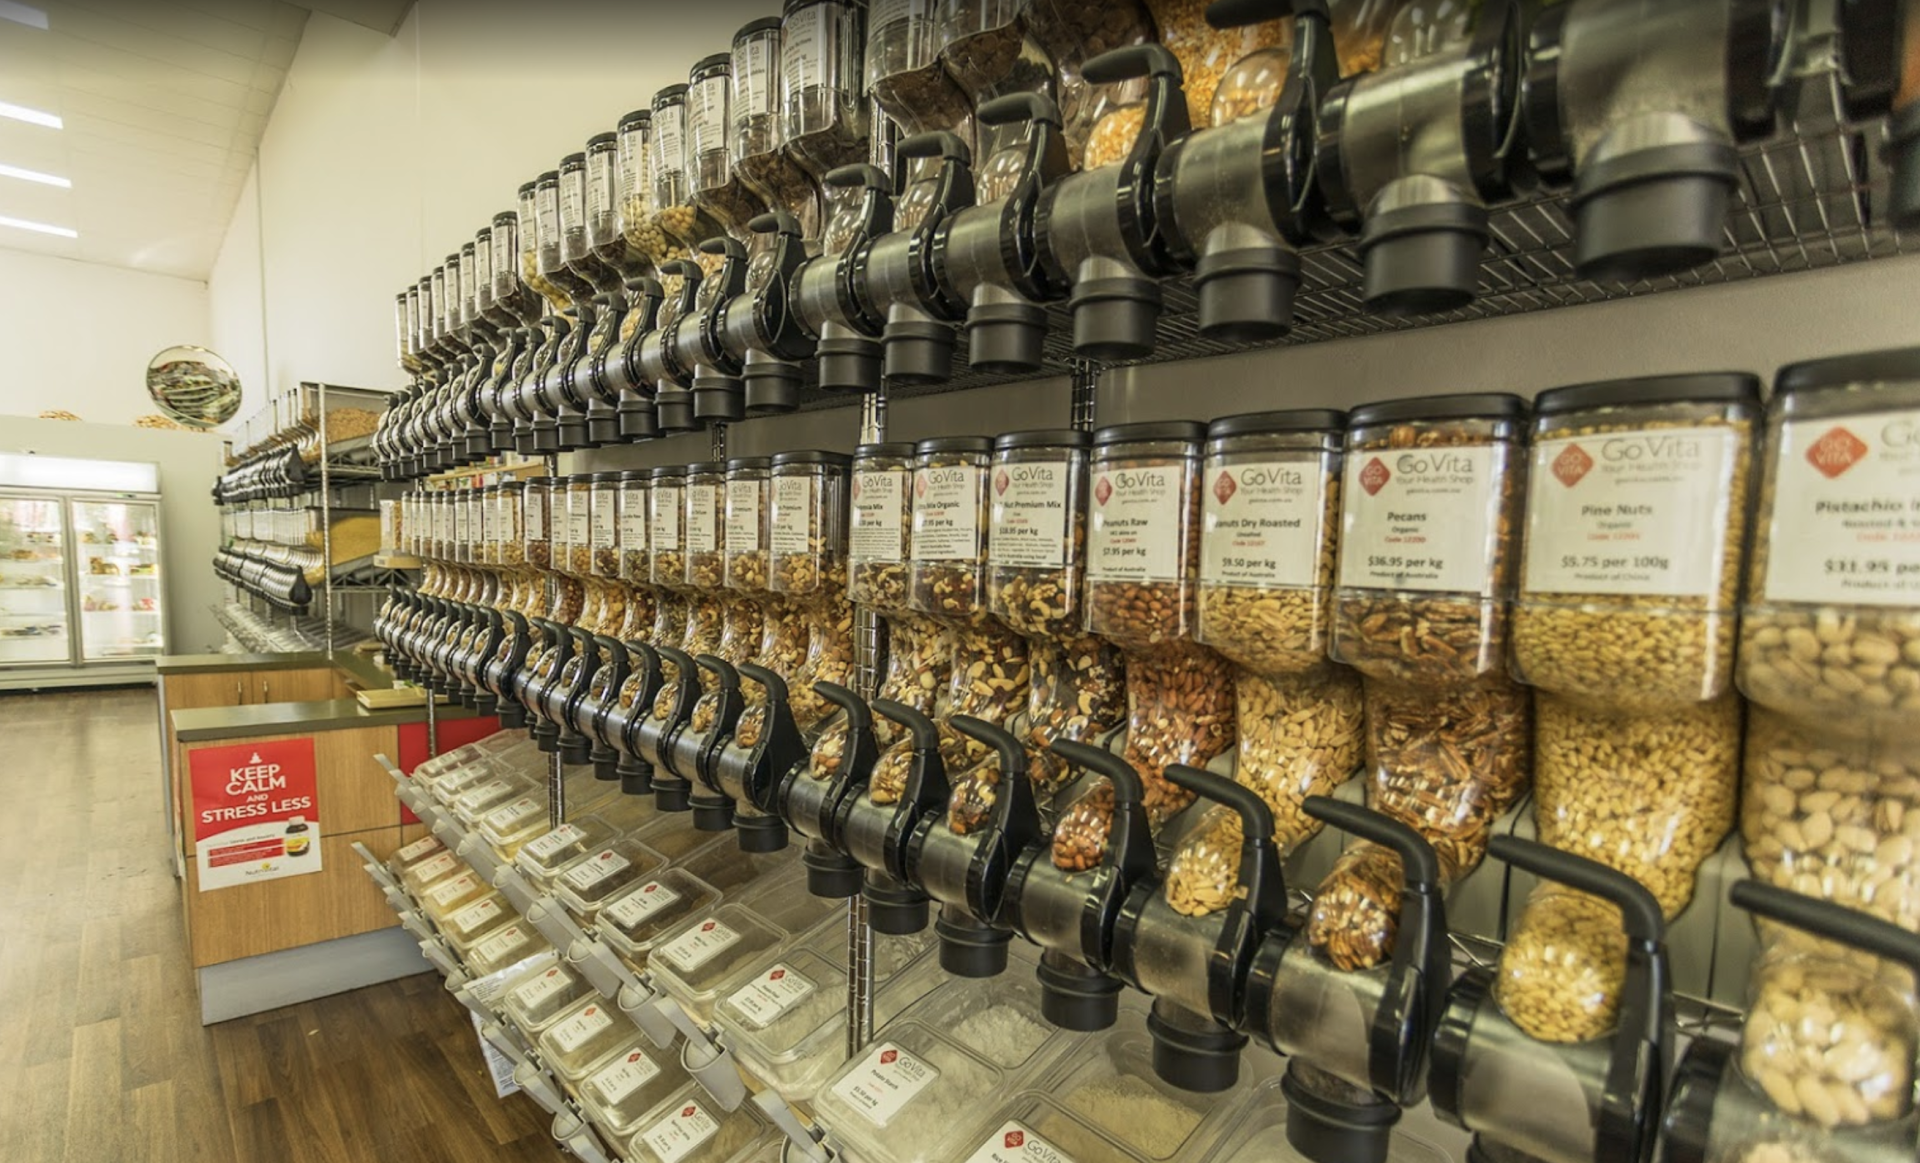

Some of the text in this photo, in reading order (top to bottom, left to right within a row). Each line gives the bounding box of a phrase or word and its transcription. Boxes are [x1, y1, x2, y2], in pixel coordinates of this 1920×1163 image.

[937, 501, 960, 511] Organic
[1014, 501, 1045, 509] Premium
[1046, 501, 1062, 509] Mix
[1581, 504, 1654, 517] Pine Nuts
[1815, 500, 1904, 515] Pistachio
[1130, 518, 1148, 526] Raw
[1387, 512, 1427, 523] Pecans
[1241, 519, 1258, 529] Dry
[1259, 519, 1301, 528] Roasted
[1122, 548, 1135, 557] per
[1136, 547, 1147, 557] kg
[1246, 560, 1262, 569] per
[1264, 559, 1277, 570] kg
[1368, 555, 1444, 570] $36.95 per kg
[1561, 556, 1670, 571] $5.75 per 100g
[230, 764, 280, 781] KEEP
[226, 776, 286, 795] CALM
[246, 793, 268, 803] AND
[202, 796, 312, 823] STRESS LESS
